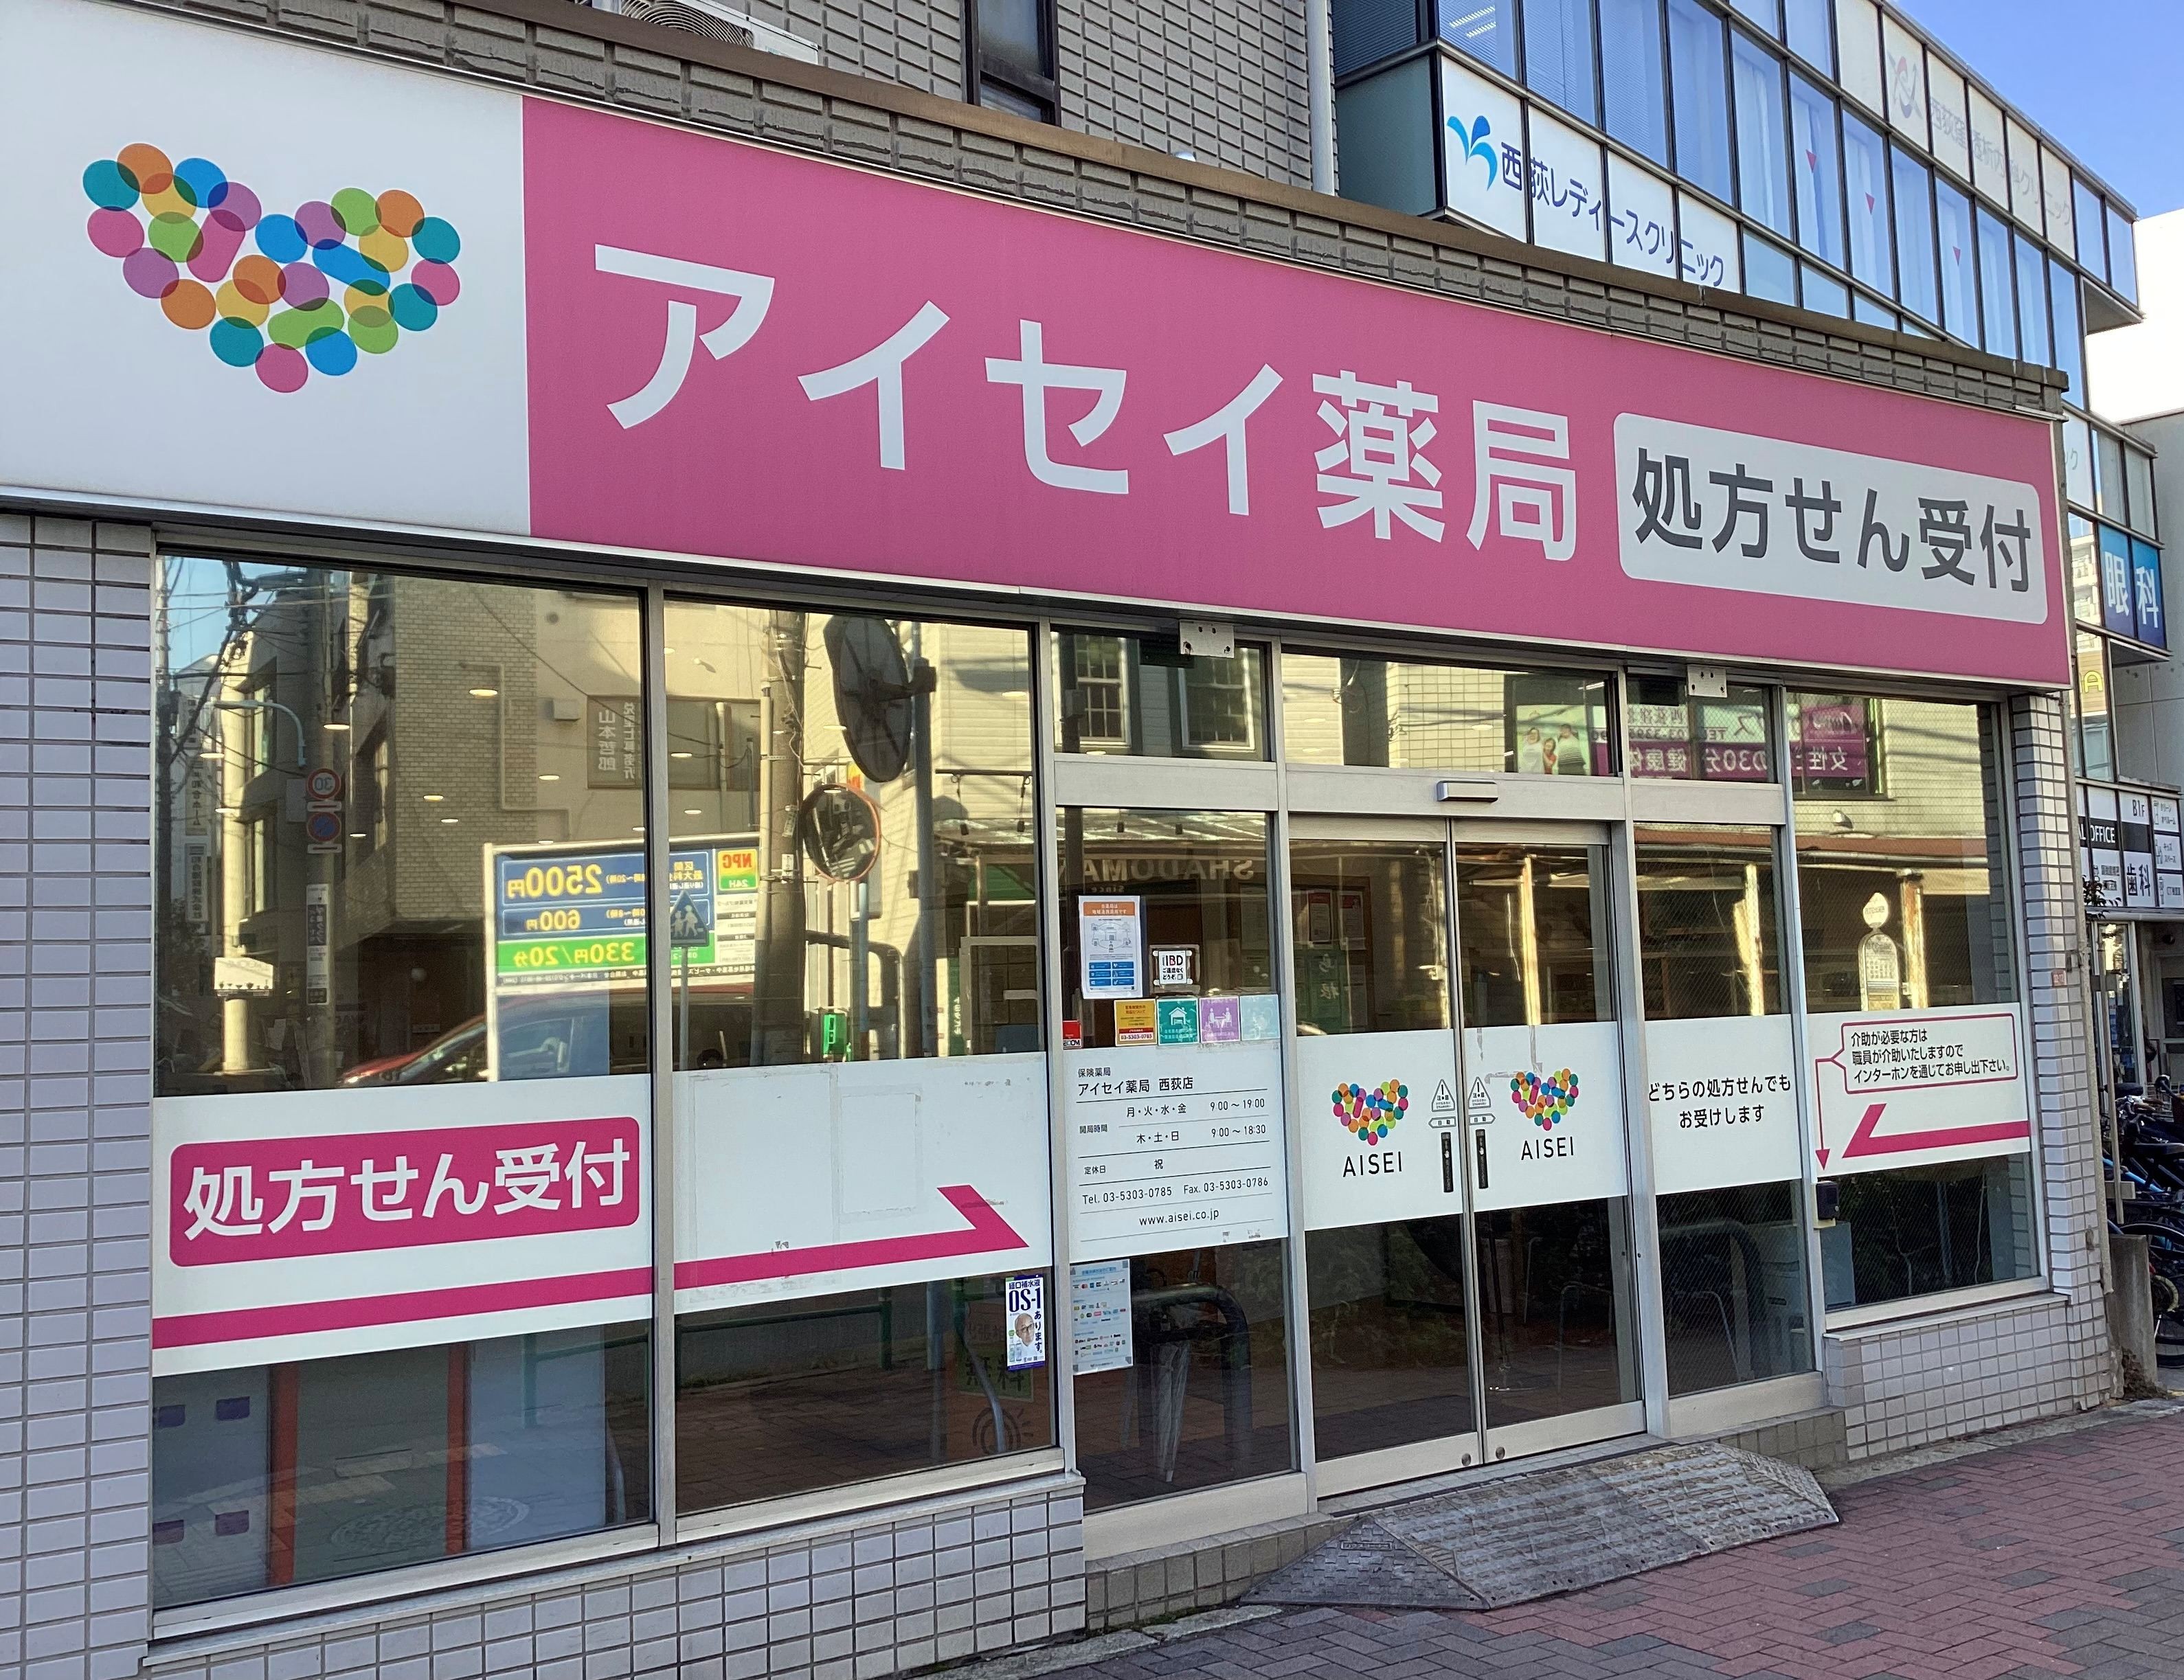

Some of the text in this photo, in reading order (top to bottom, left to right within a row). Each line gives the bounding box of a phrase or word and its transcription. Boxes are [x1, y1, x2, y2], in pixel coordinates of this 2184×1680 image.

[1500, 141, 1725, 288] 西荻レディースクリニック
[594, 243, 1577, 562] アイセイ薬局
[1632, 446, 2031, 593] 処方せん受付
[2104, 551, 2159, 628] 眼科
[2126, 863, 2151, 897] 歯科
[1165, 955, 1184, 966] IBD
[1850, 1028, 1928, 1047] 介助が必要な方は
[1851, 1043, 1964, 1066] 職員が介助いたしますので
[1077, 1067, 1112, 1078] 保険薬局
[1854, 1058, 2011, 1084] インターホンを通じてお申し出下さい。
[1077, 1076, 1194, 1097] アイセイ薬局 西荻店
[1648, 1074, 1792, 1102] どちらの処方せんでも
[1125, 1102, 1188, 1118] 月・火・水・金
[1678, 1104, 1766, 1129] お受けします
[1079, 1123, 1109, 1135] 開局時間
[1136, 1130, 1180, 1144] 木・土・日
[1520, 1136, 1575, 1161] AISEI
[1083, 1158, 1164, 1176] 定休日 祝
[1342, 1151, 1403, 1178] AISEI
[183, 1137, 630, 1242] 処方せん受付
[1082, 1176, 1269, 1205] Tel. 03-5303-0785 Fax. 03-5303-0786
[1138, 1208, 1220, 1227] www.aisei.co.jp
[1009, 1279, 1041, 1290] 経口補水液
[1009, 1287, 1042, 1313] OS-1
[1034, 1310, 1043, 1354] あります。
